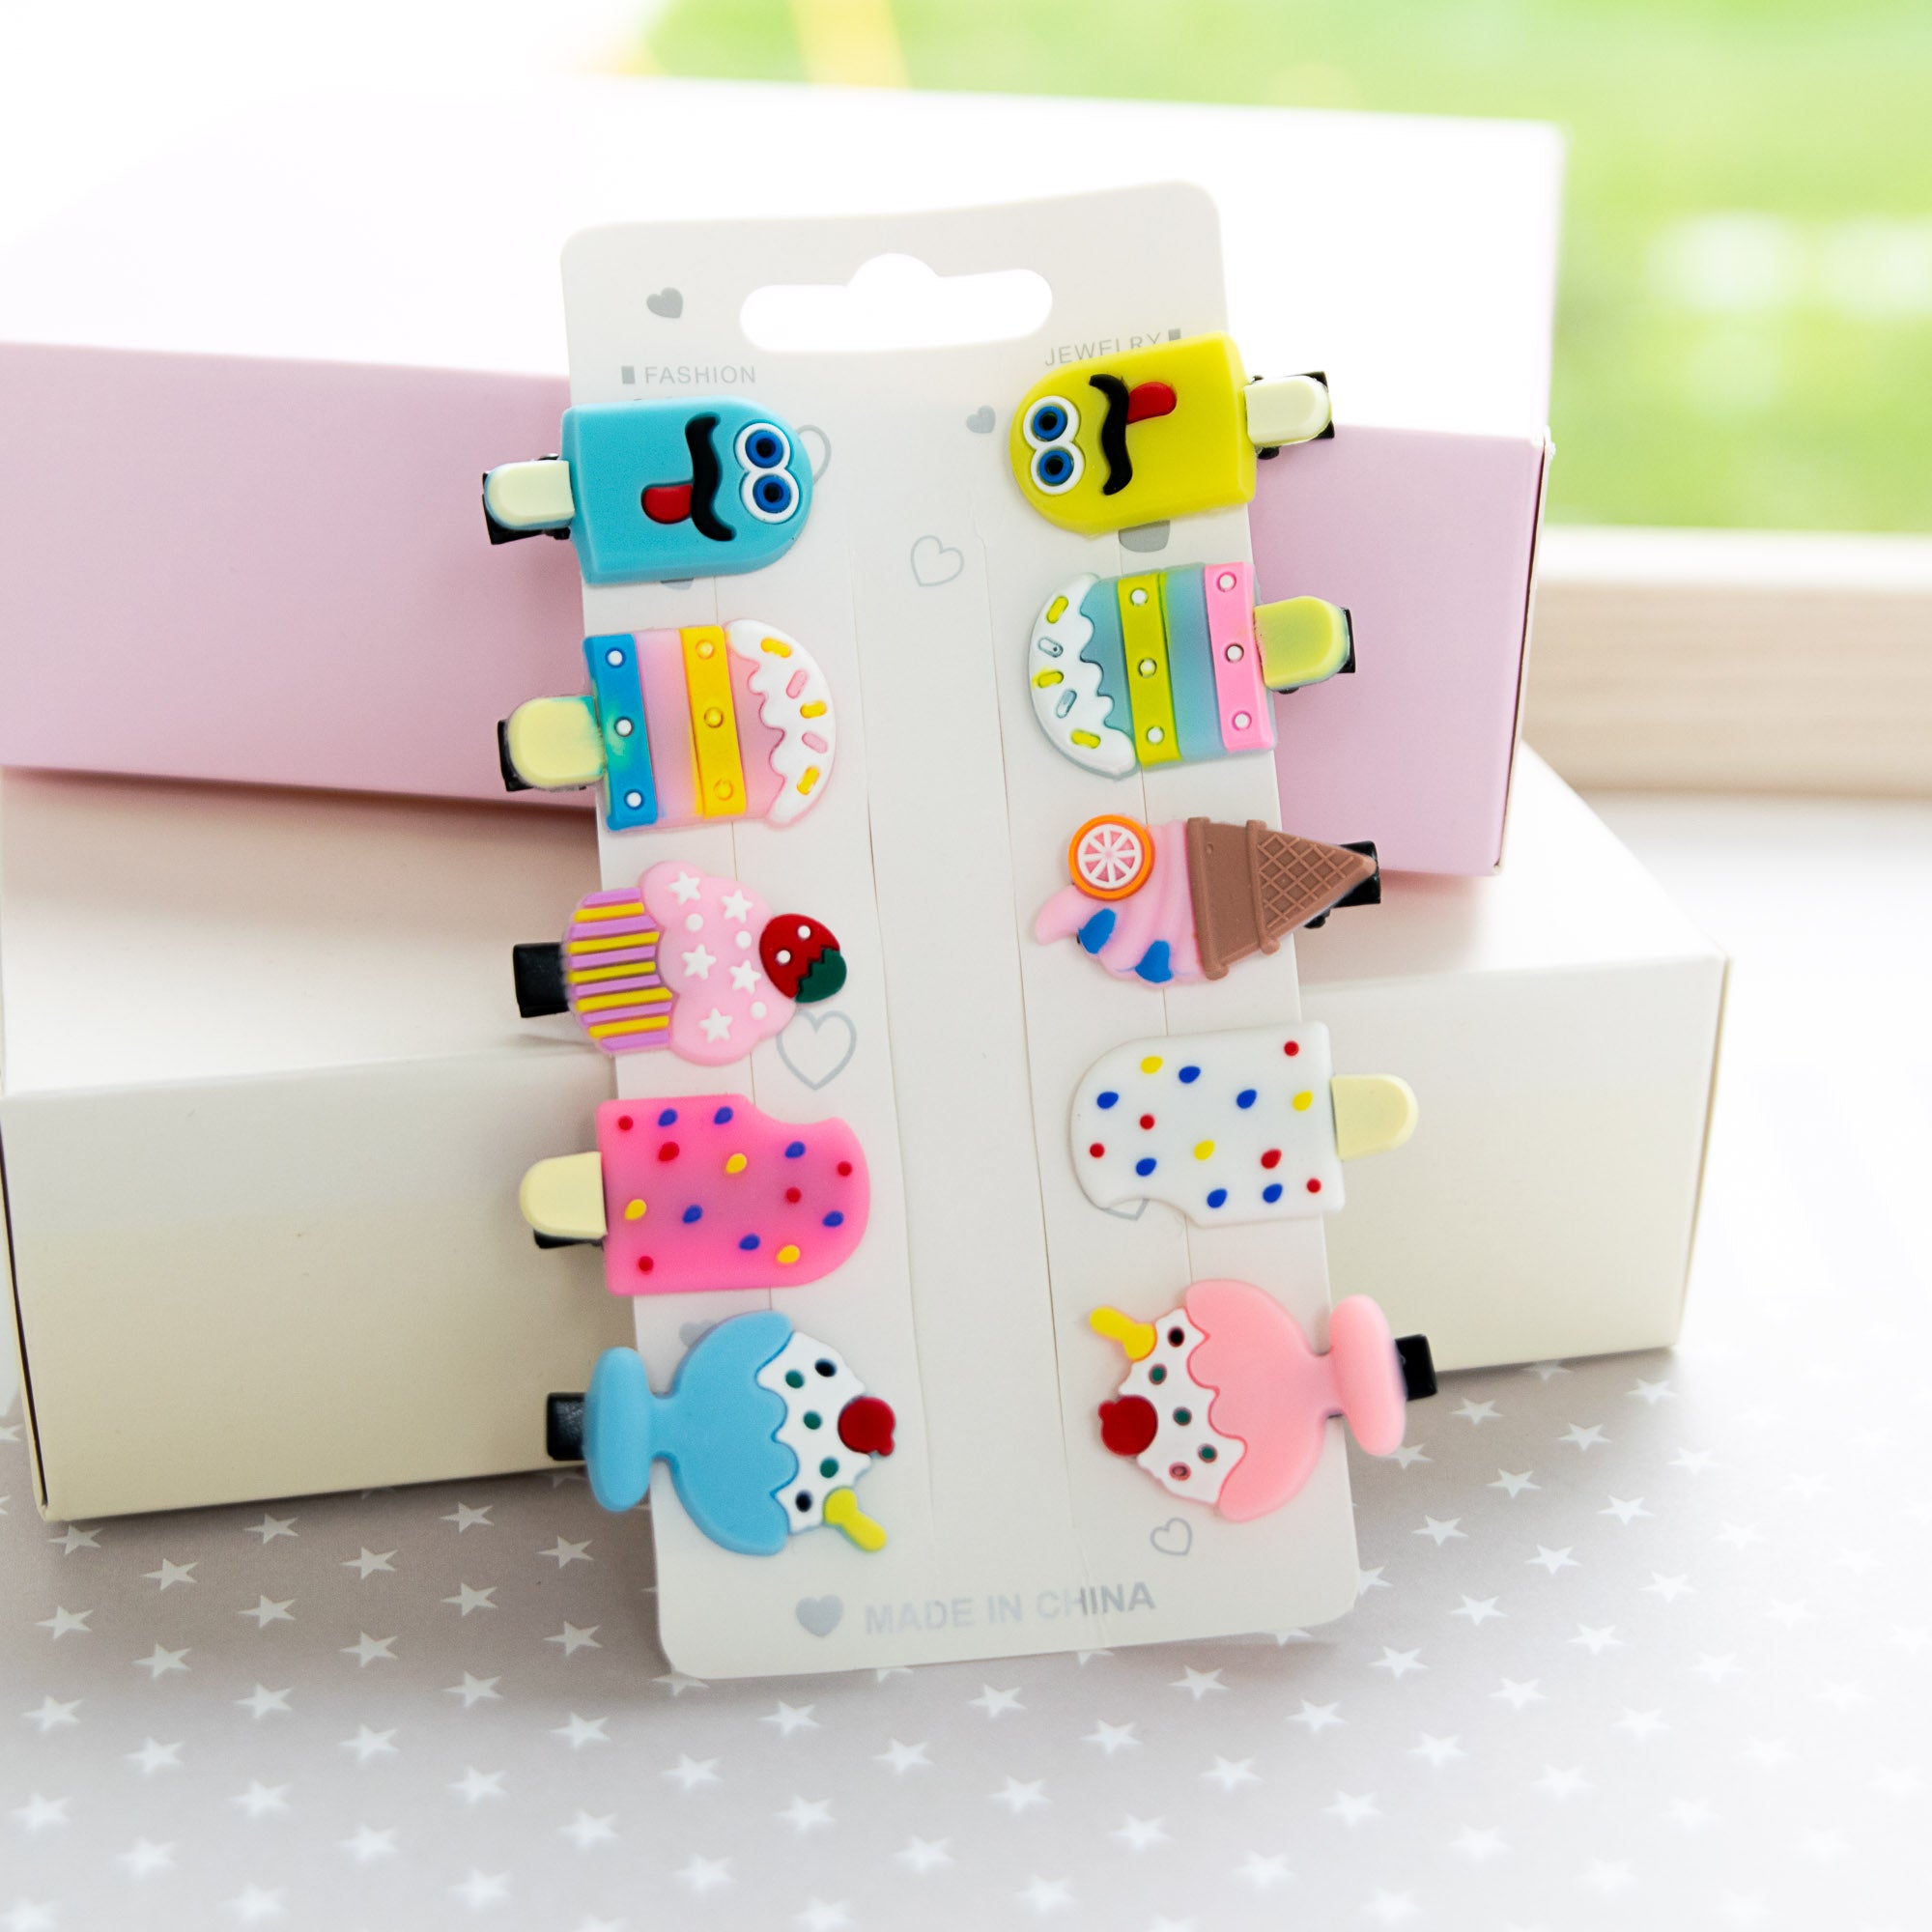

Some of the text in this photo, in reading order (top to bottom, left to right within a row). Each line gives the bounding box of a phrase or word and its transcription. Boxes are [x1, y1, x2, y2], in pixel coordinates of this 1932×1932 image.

[644, 365, 756, 384] FASHION
[865, 1581, 1156, 1635] MADE IN CHINA
